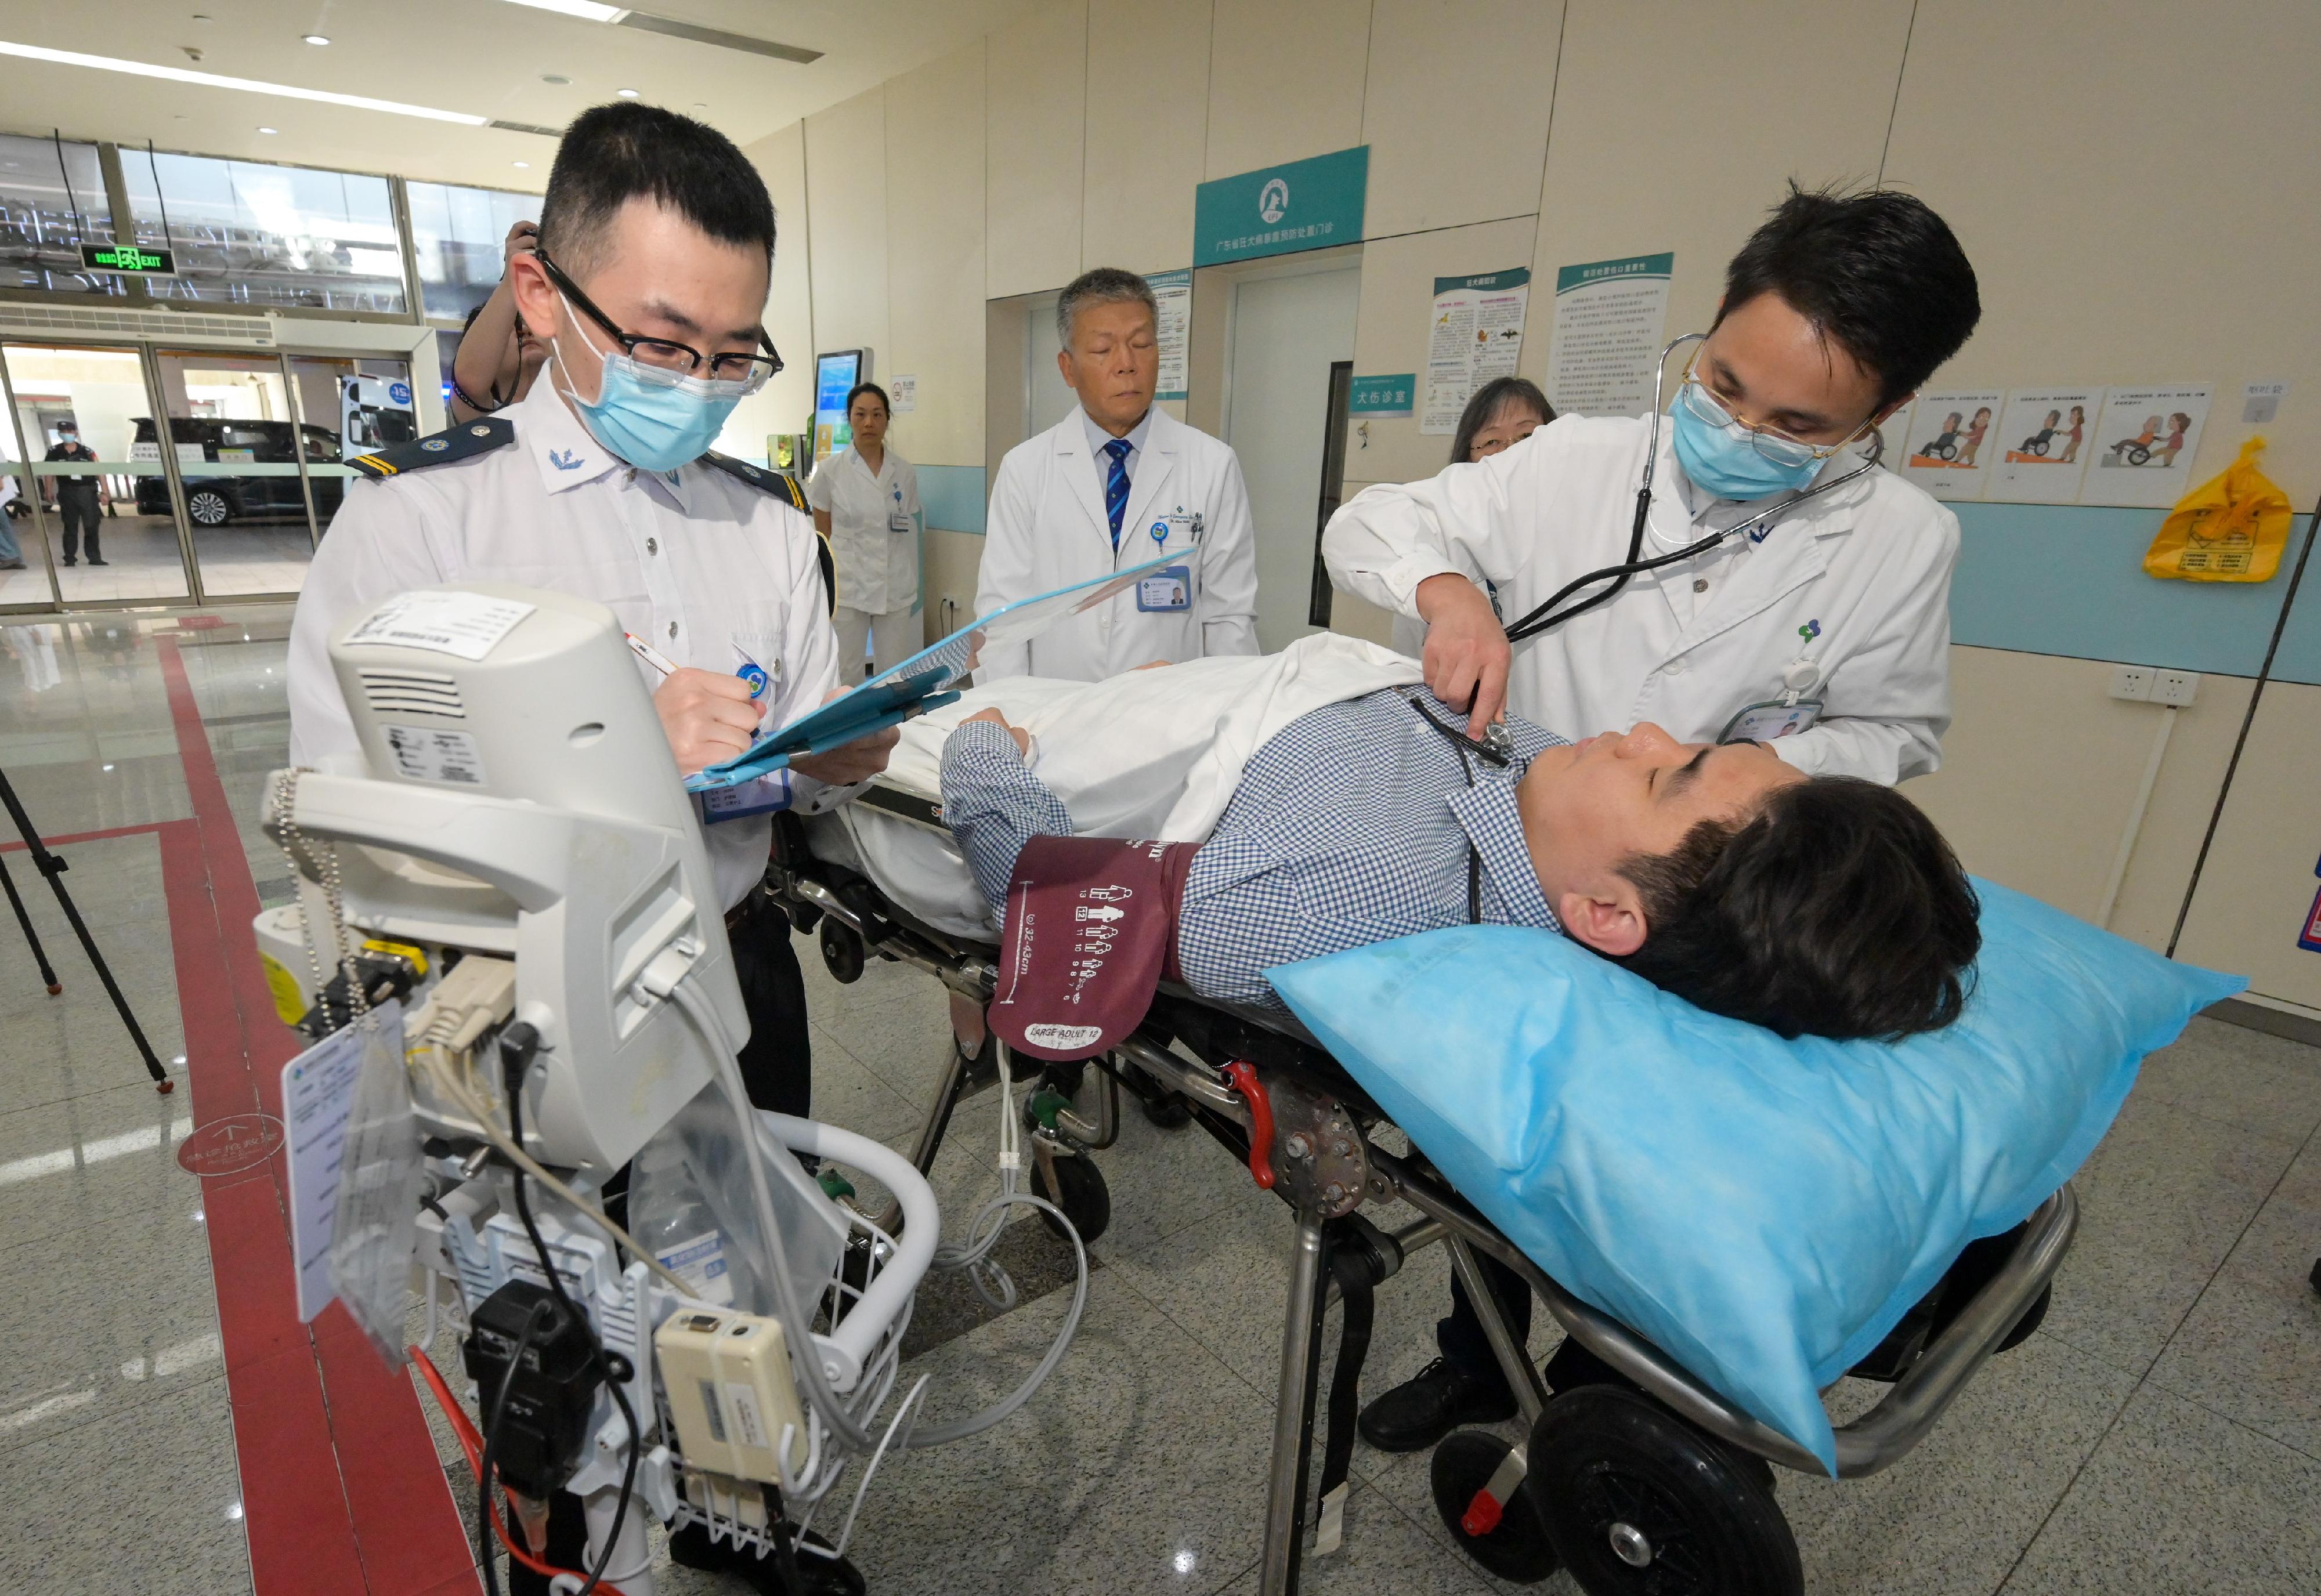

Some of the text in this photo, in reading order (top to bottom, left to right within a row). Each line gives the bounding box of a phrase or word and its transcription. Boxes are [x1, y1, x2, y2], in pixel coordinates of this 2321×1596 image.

[141, 255, 161, 267] EXIT
[1357, 390, 1405, 404] 犬伤诊室
[1079, 889, 1087, 898] 13
[1078, 907, 1086, 920] 12
[1021, 927, 1035, 976] 32-43cm
[1075, 943, 1082, 952] 10
[1030, 1027, 1099, 1038] LARGE ADULT 12
